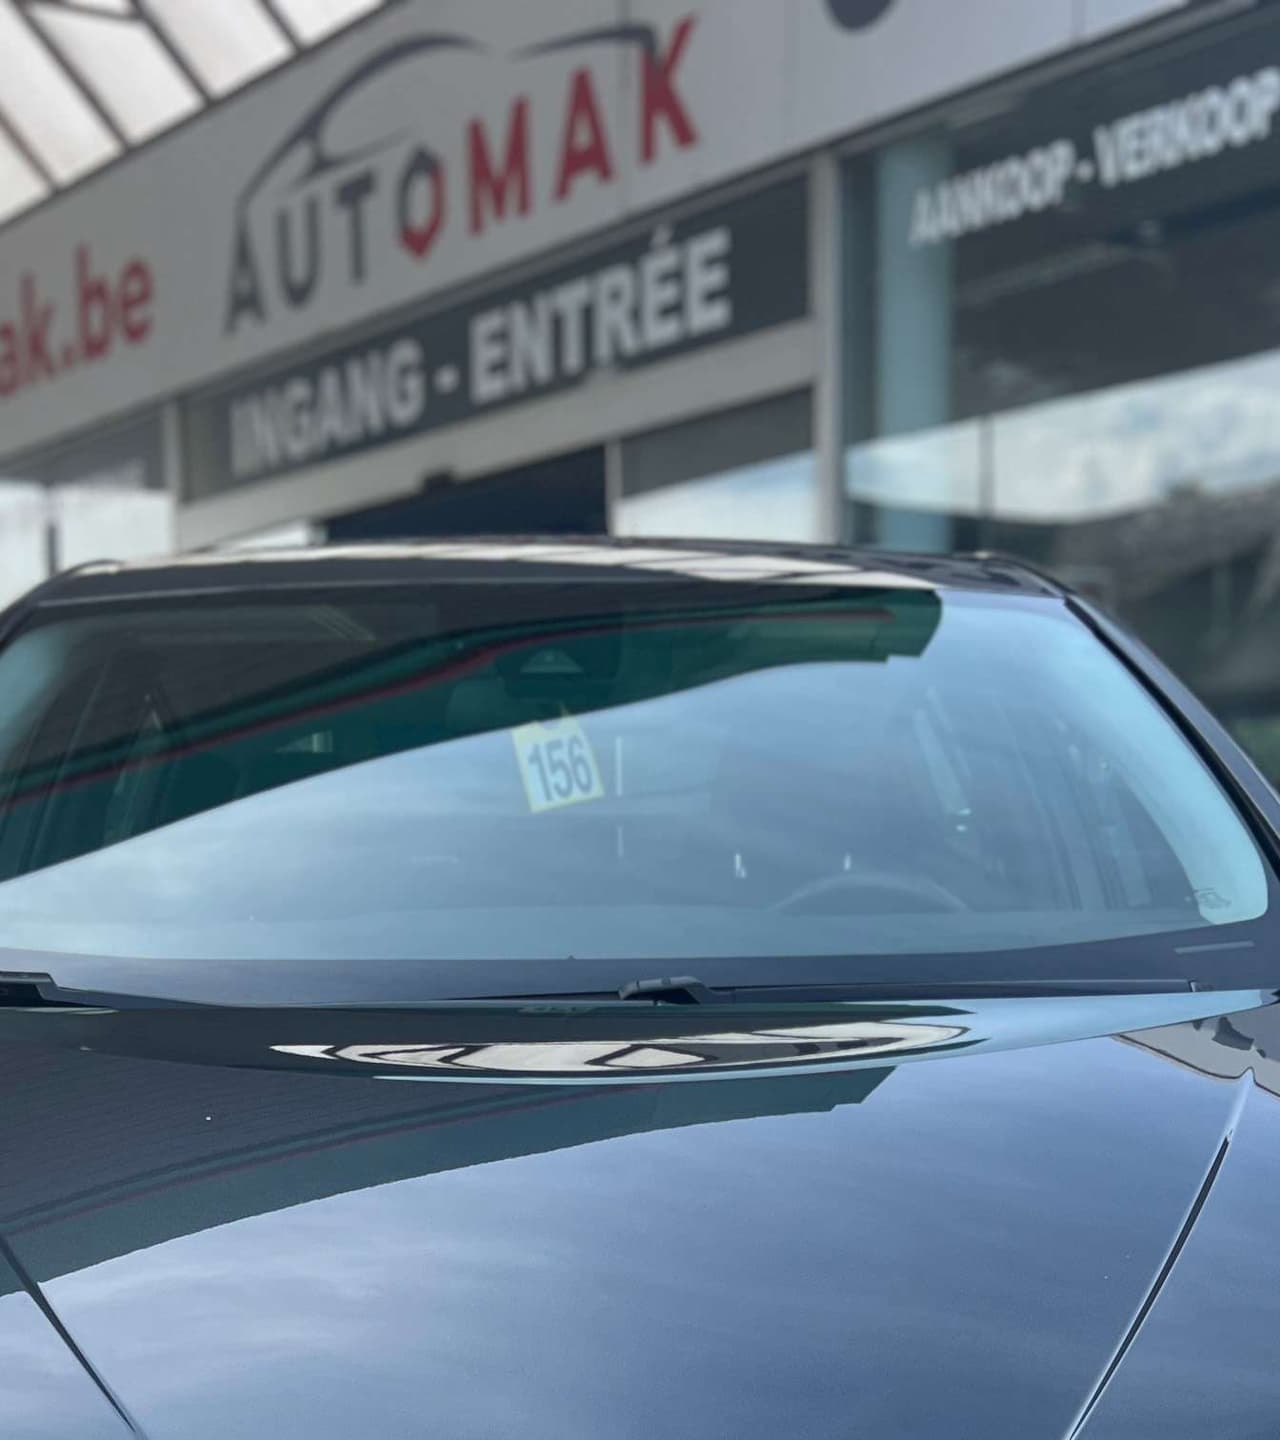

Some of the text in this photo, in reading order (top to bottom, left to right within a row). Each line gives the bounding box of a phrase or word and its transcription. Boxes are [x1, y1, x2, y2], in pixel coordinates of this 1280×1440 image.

[225, 15, 699, 333] AUTOMAK
[909, 138, 1076, 247] AANKOOP
[228, 339, 424, 478] INGANG
[467, 227, 731, 403] ENTRÉE
[527, 737, 594, 803] 156
